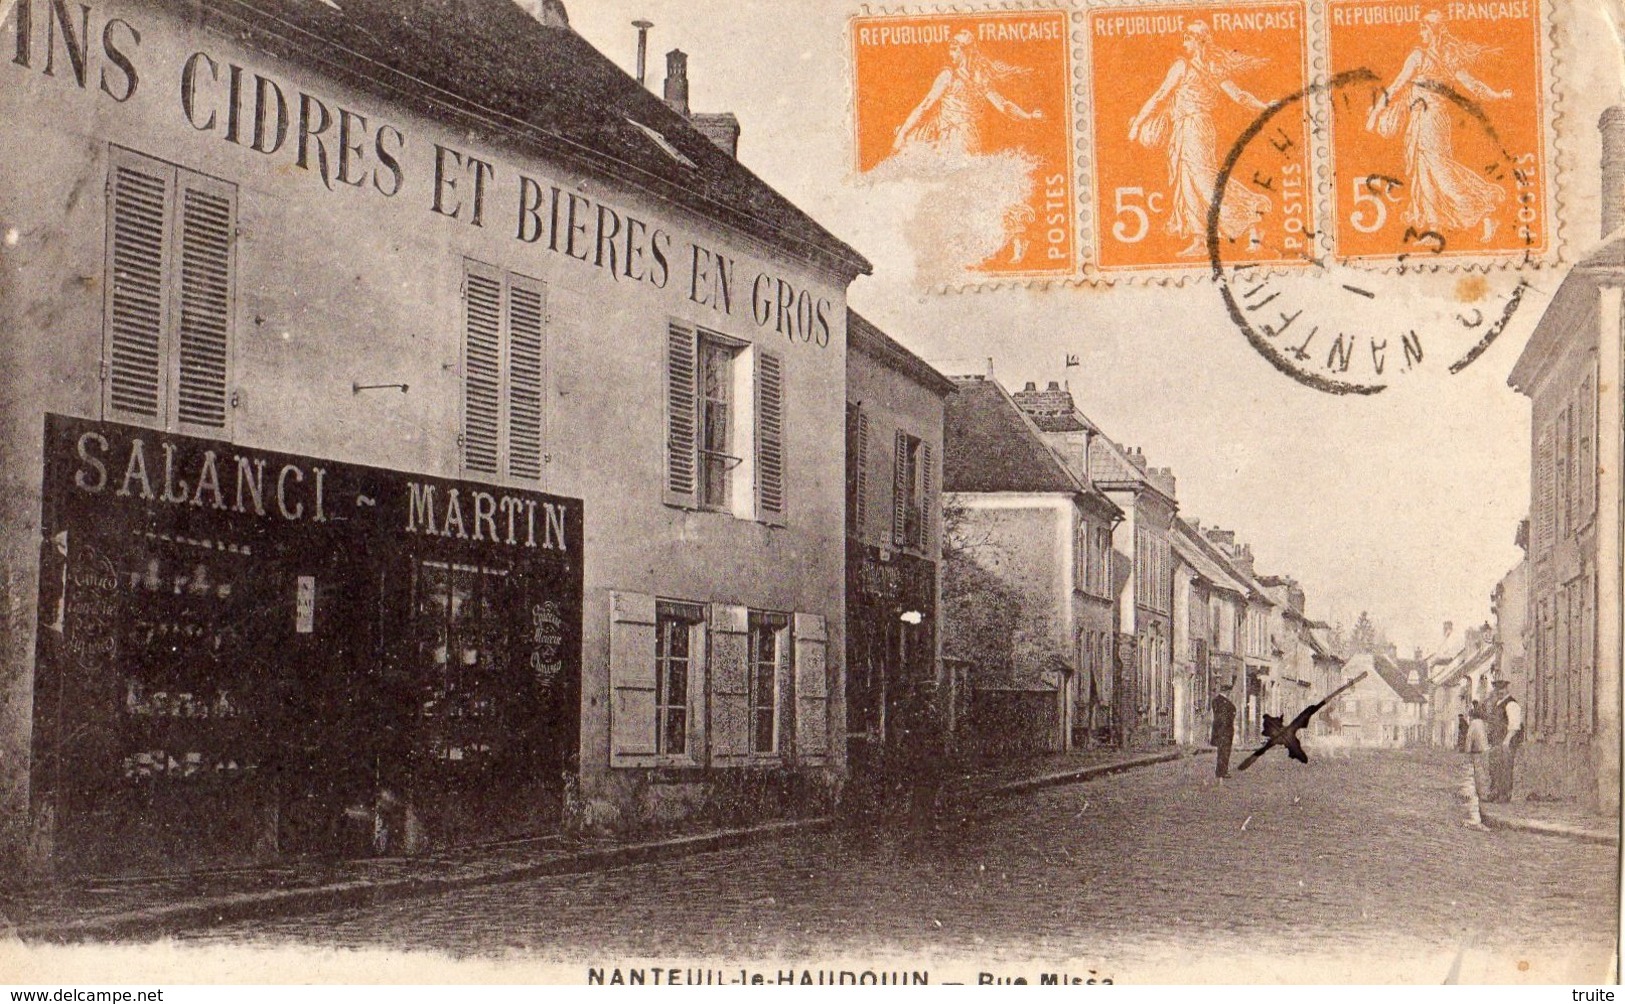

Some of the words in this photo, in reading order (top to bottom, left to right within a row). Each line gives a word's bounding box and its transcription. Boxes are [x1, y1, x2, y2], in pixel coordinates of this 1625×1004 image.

[860, 24, 951, 46] REPUBLIQUE
[978, 20, 1060, 43] FRANÇAISE
[1096, 14, 1185, 37] REPUBLIQUE
[1213, 9, 1297, 32] FRANÇAISE
[1333, 5, 1421, 26] REPUBLIQUE
[1448, 1, 1530, 20] FRANÇAISE
[180, 51, 405, 197] CIDRES
[430, 142, 495, 228] ET
[516, 175, 671, 289] BIÈRES
[689, 242, 735, 315] EN
[751, 272, 831, 349] GROS
[1045, 173, 1066, 260] POSTES
[1281, 163, 1303, 250] POSTES
[75, 432, 327, 523] SALANCI
[405, 481, 567, 551] MARTIN
